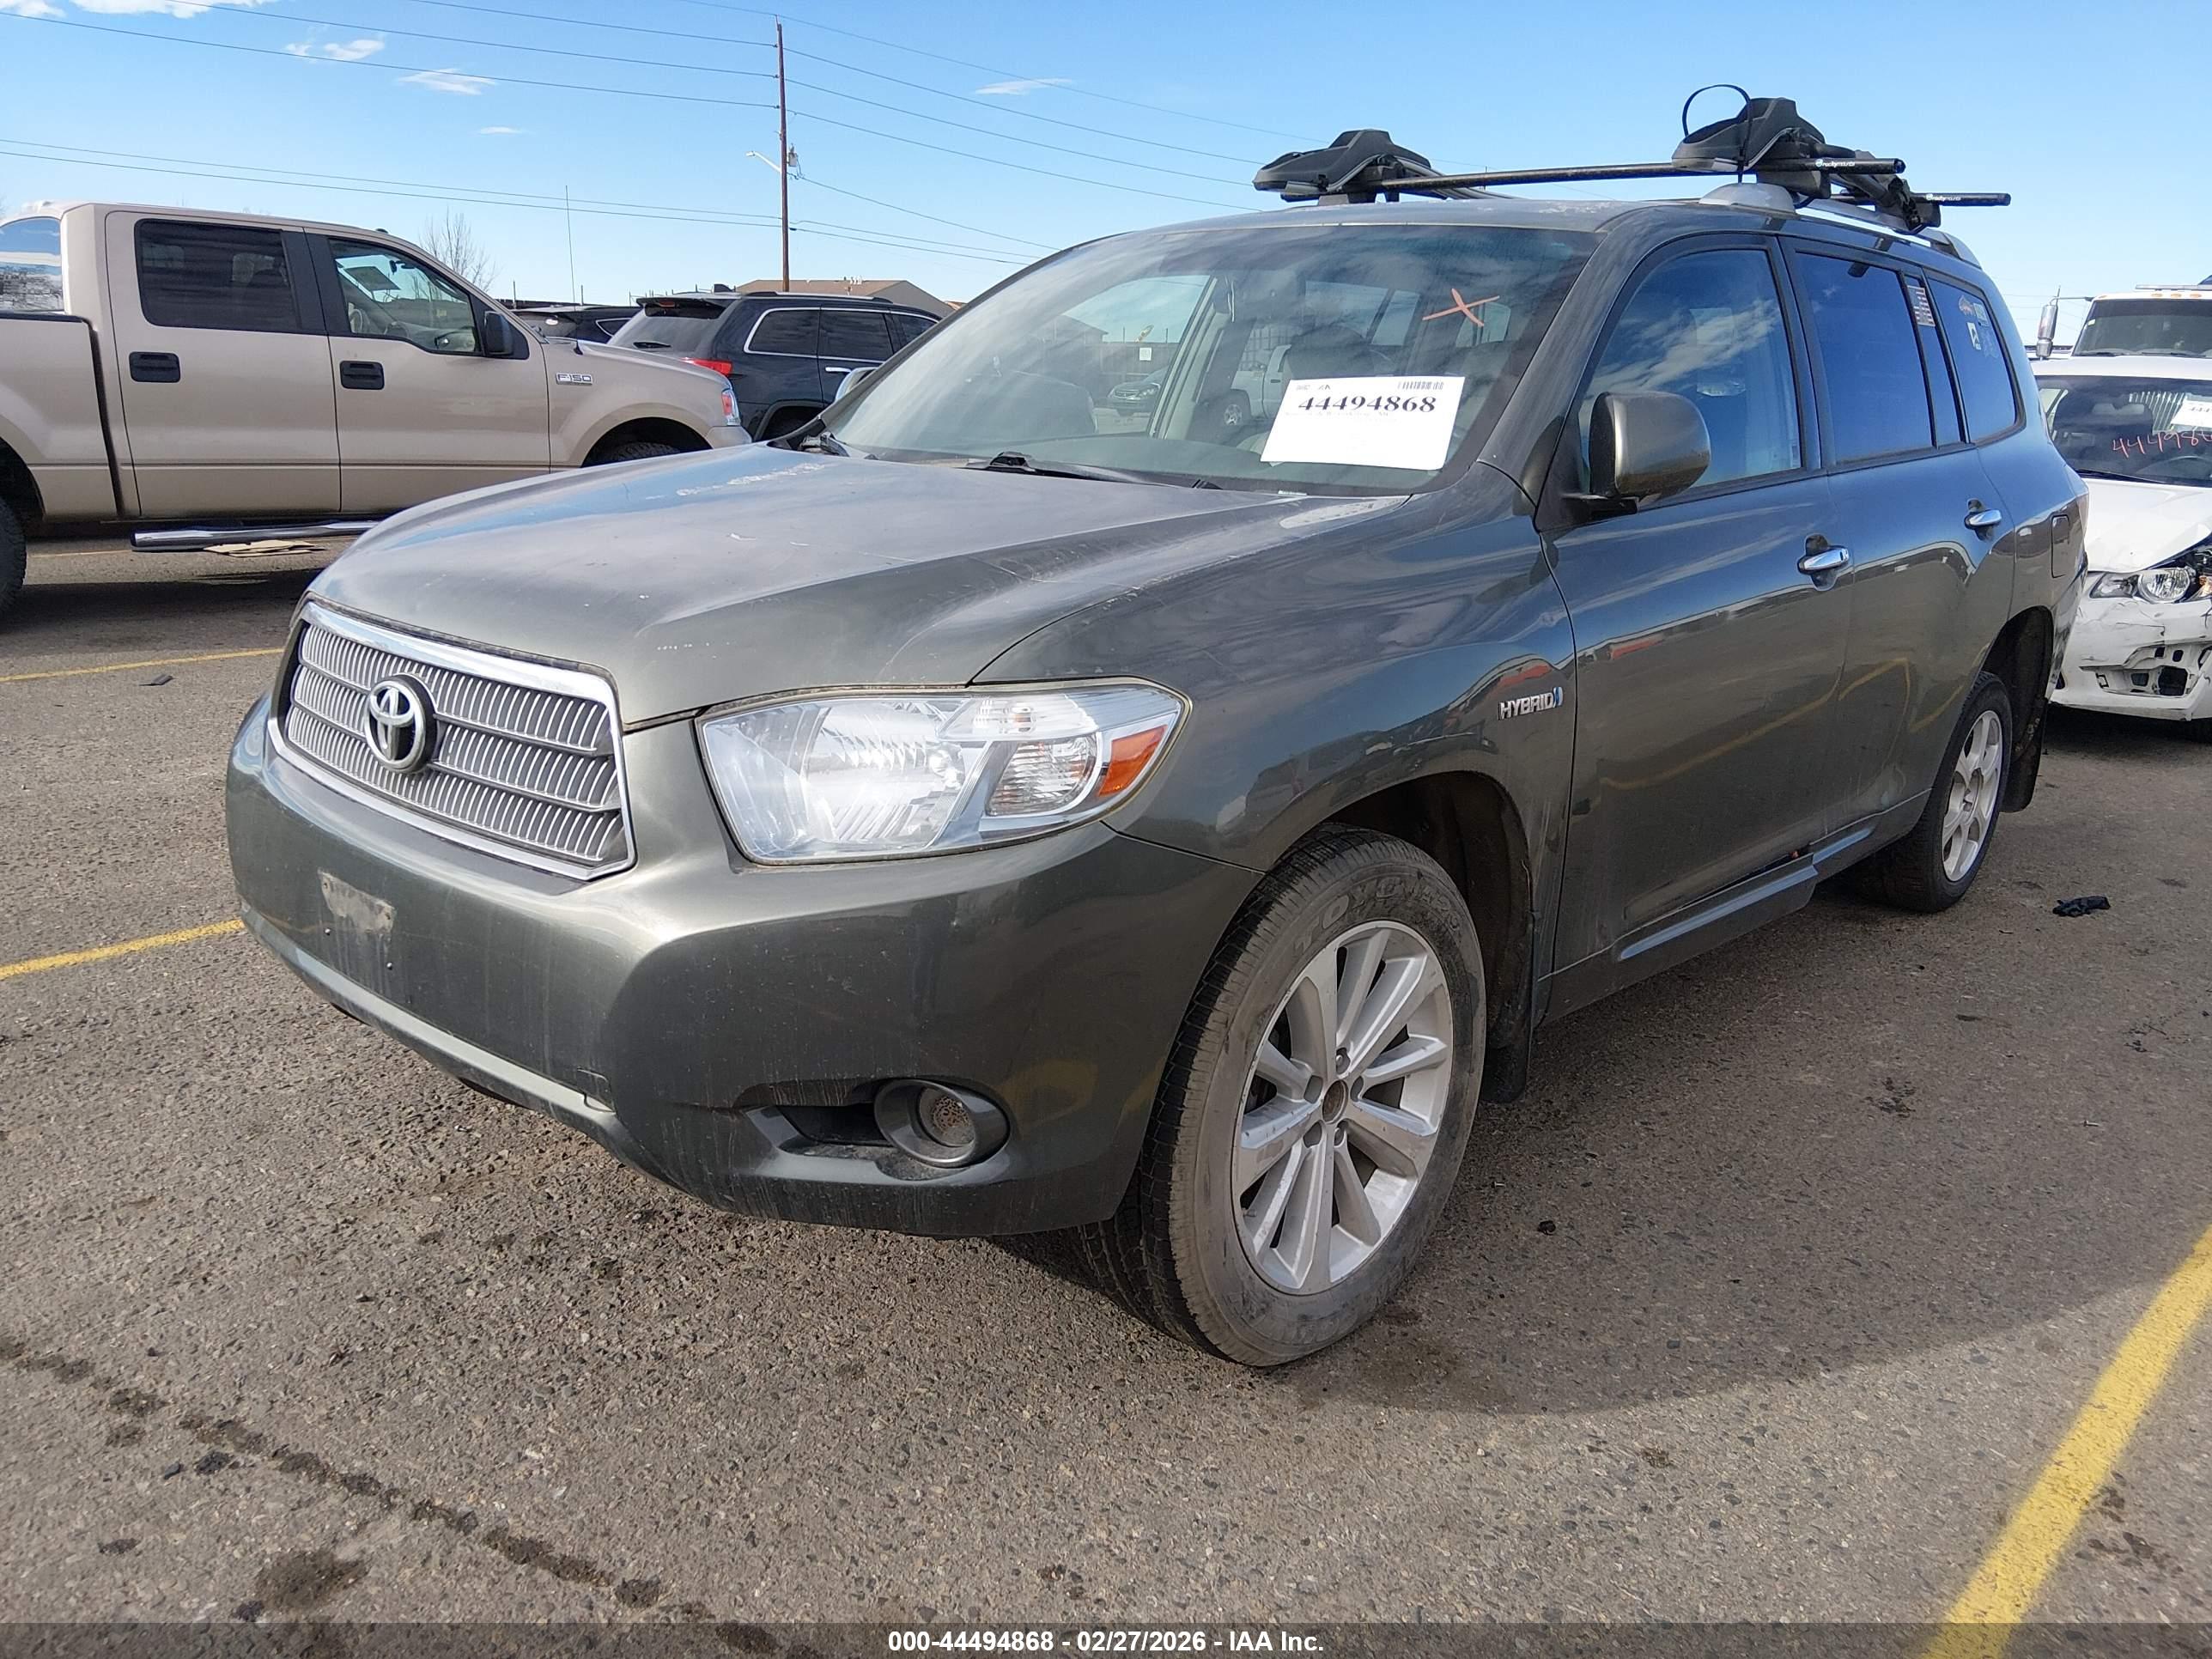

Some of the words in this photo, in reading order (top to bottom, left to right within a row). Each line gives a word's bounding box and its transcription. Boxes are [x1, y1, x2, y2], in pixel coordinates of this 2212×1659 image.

[557, 374, 592, 382] F-150
[1297, 395, 1437, 413] 44494868
[1500, 691, 1555, 720] HYBRID
